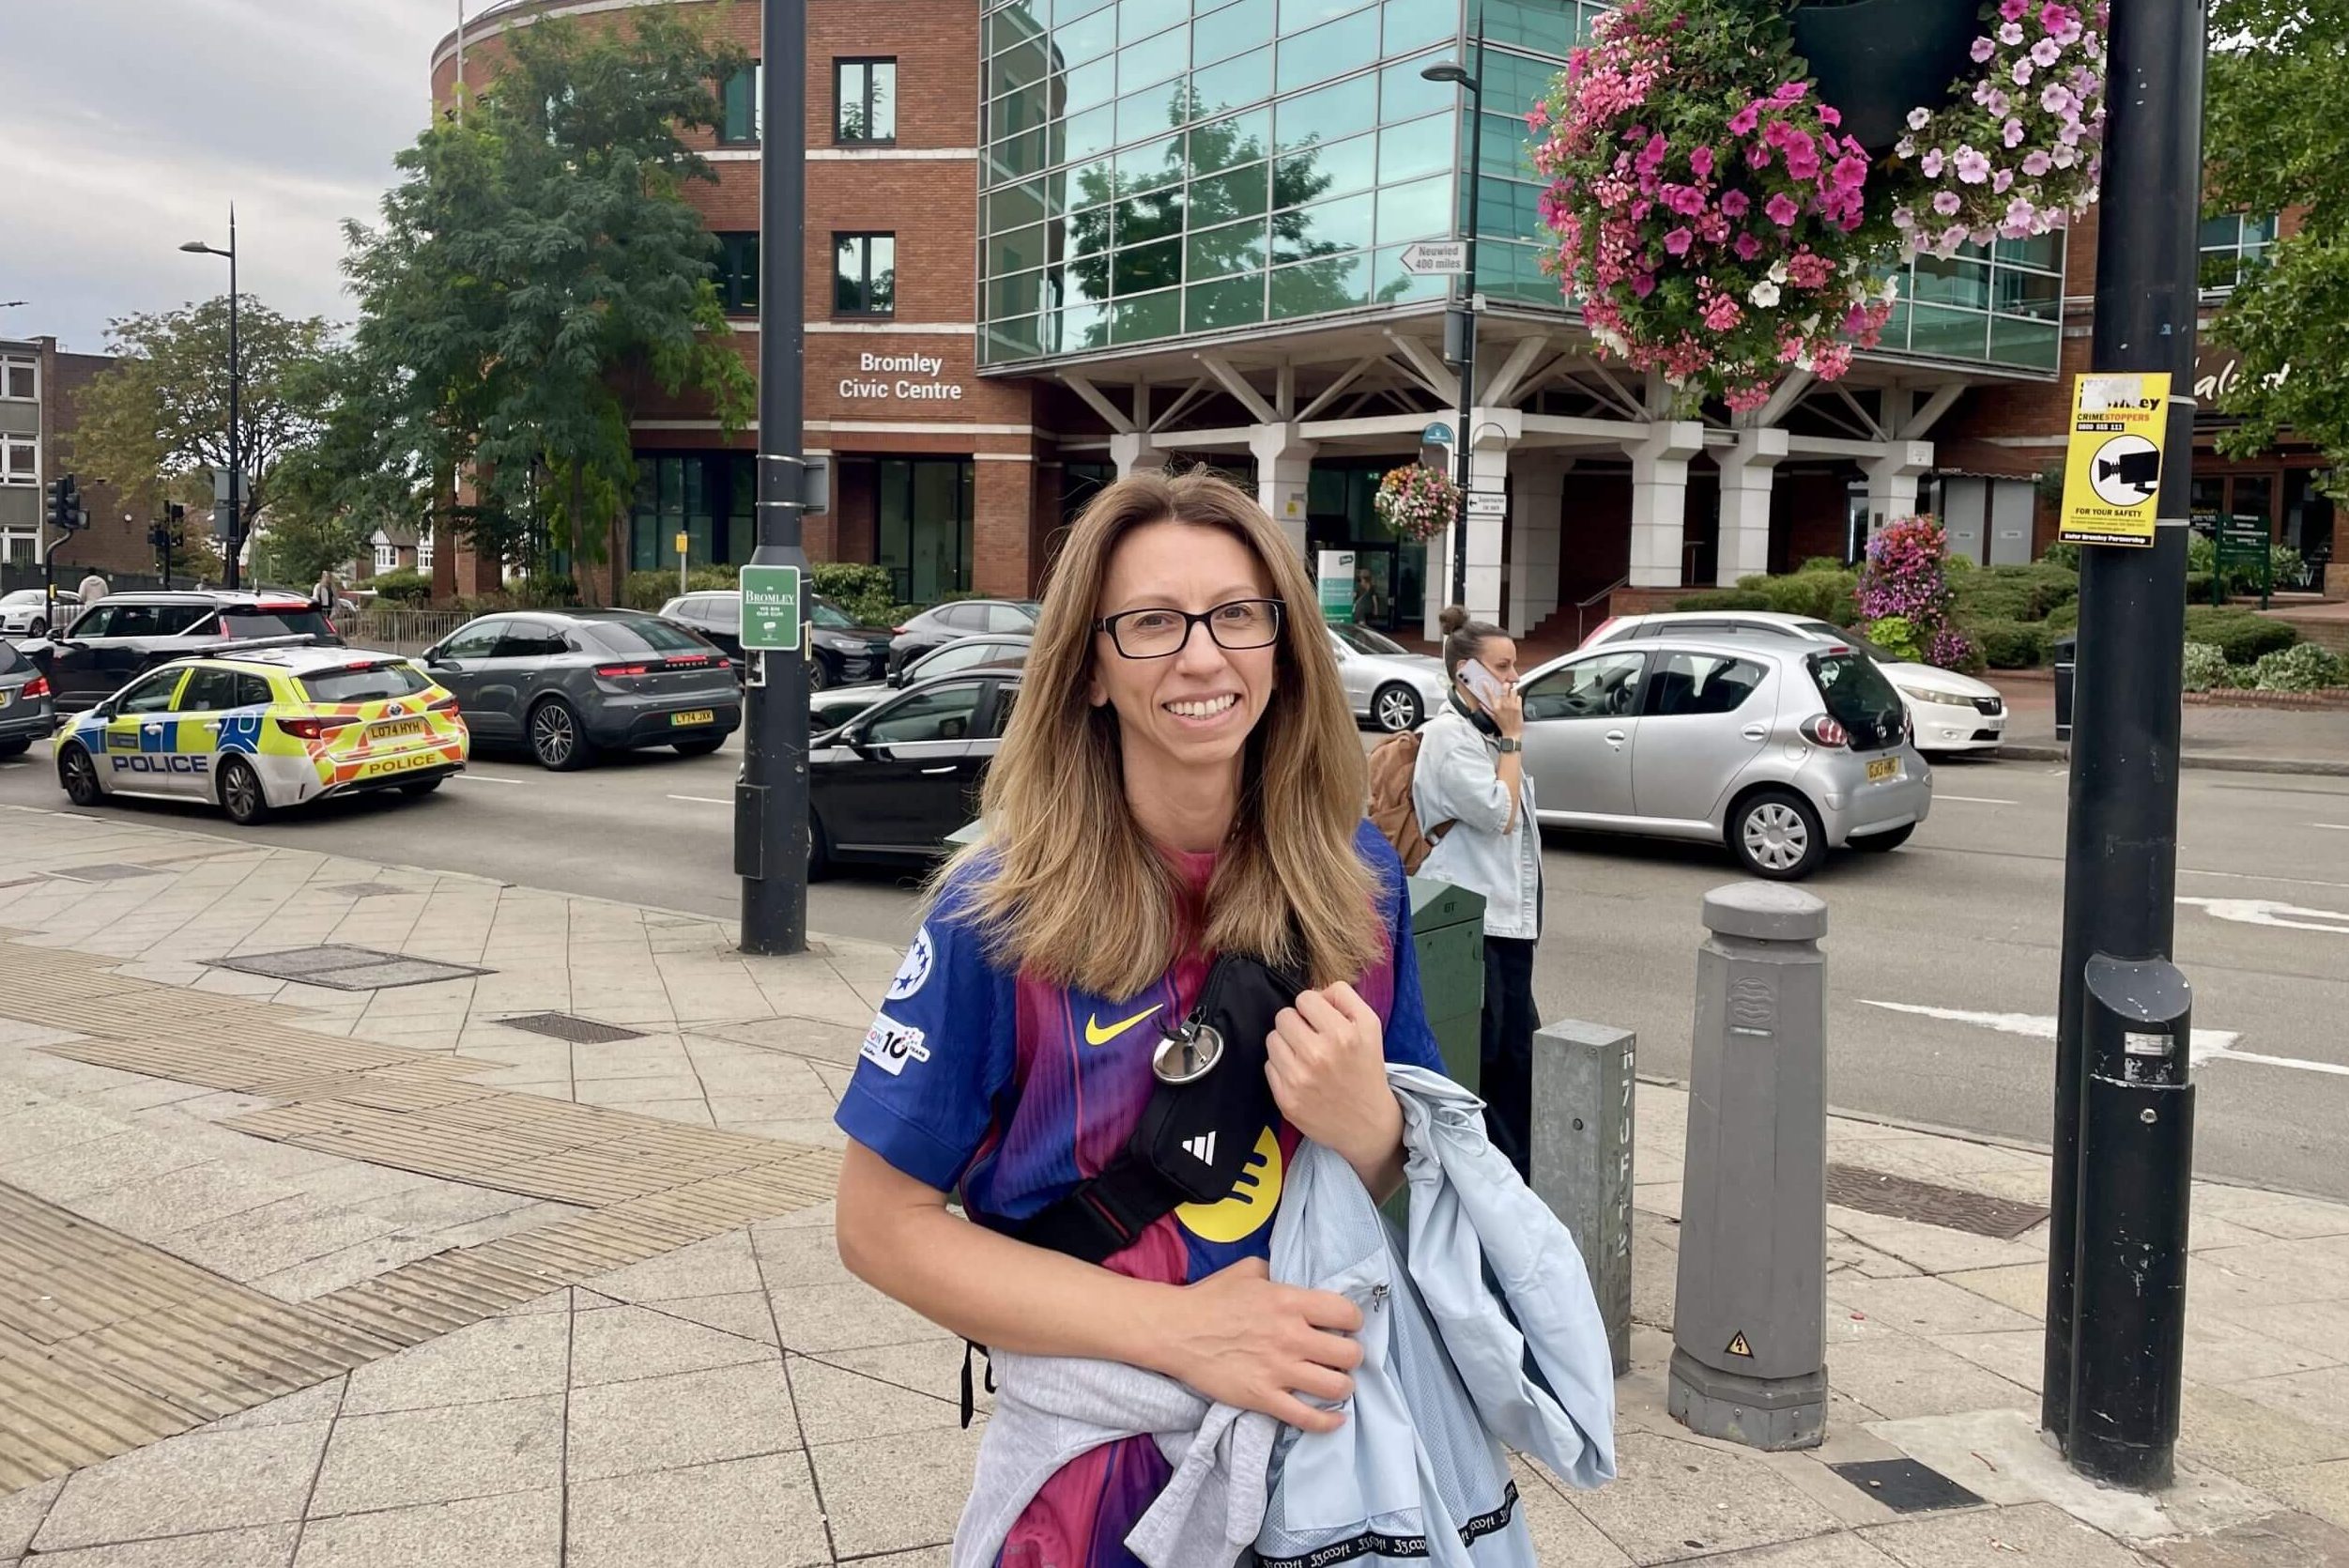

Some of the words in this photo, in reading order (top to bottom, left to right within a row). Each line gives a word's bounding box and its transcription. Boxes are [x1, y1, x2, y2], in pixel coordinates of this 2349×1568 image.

[1419, 245, 1459, 256] Neuwied
[1416, 258, 1434, 269] 400
[1436, 258, 1461, 269] miles
[860, 352, 943, 377] Bromley
[839, 378, 889, 398] Civic
[895, 379, 962, 400] Centre
[2077, 413, 2150, 422] CRIMESTOPPERS
[2093, 509, 2112, 517] YOUR
[2114, 510, 2142, 518] SAFETY
[400, 721, 421, 735] HYH
[111, 755, 209, 773] POLICE
[370, 754, 437, 774] POLICE
[909, 1046, 926, 1057] YEARS
